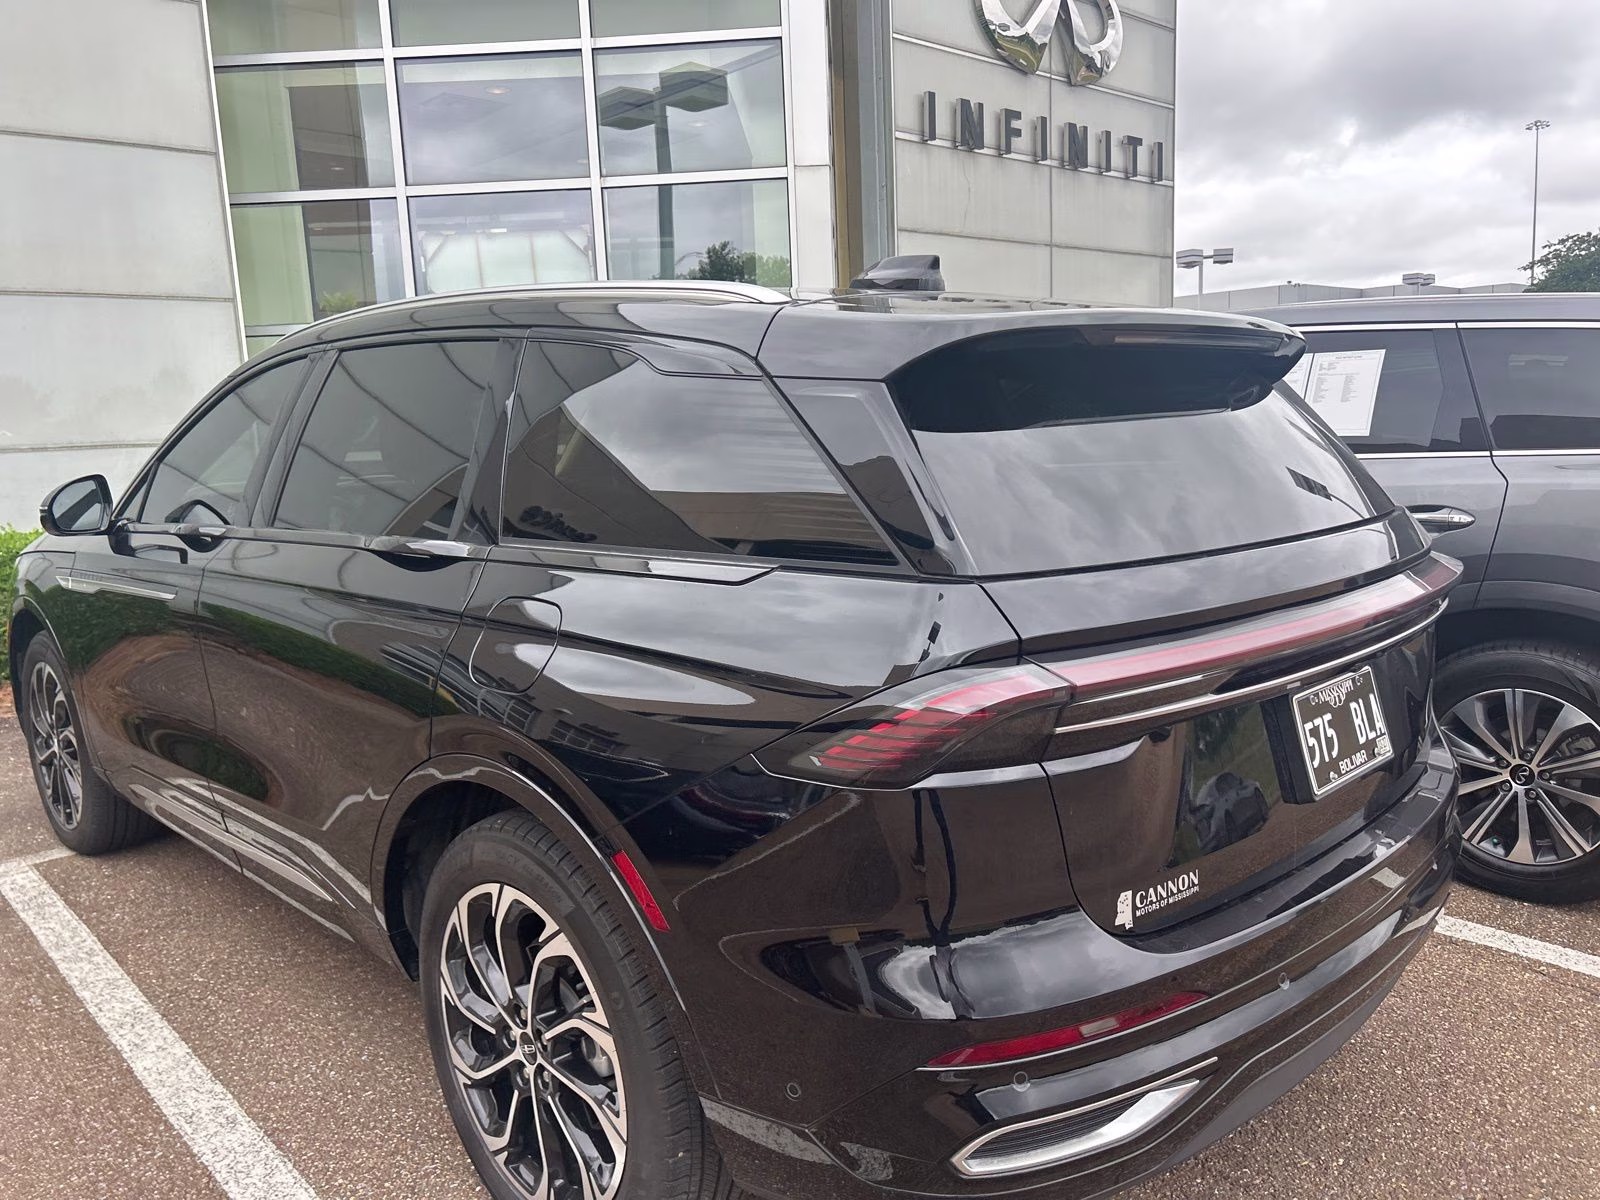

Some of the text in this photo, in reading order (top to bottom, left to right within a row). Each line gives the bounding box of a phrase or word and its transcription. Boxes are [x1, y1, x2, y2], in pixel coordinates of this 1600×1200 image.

[922, 90, 1164, 184] INFINITI
[1303, 693, 1386, 769] 575 BLA
[1338, 749, 1368, 774] BOLIVAR
[1135, 869, 1199, 908] CANNON
[1135, 885, 1200, 917] MOTORS OF MISSISSIPPI
